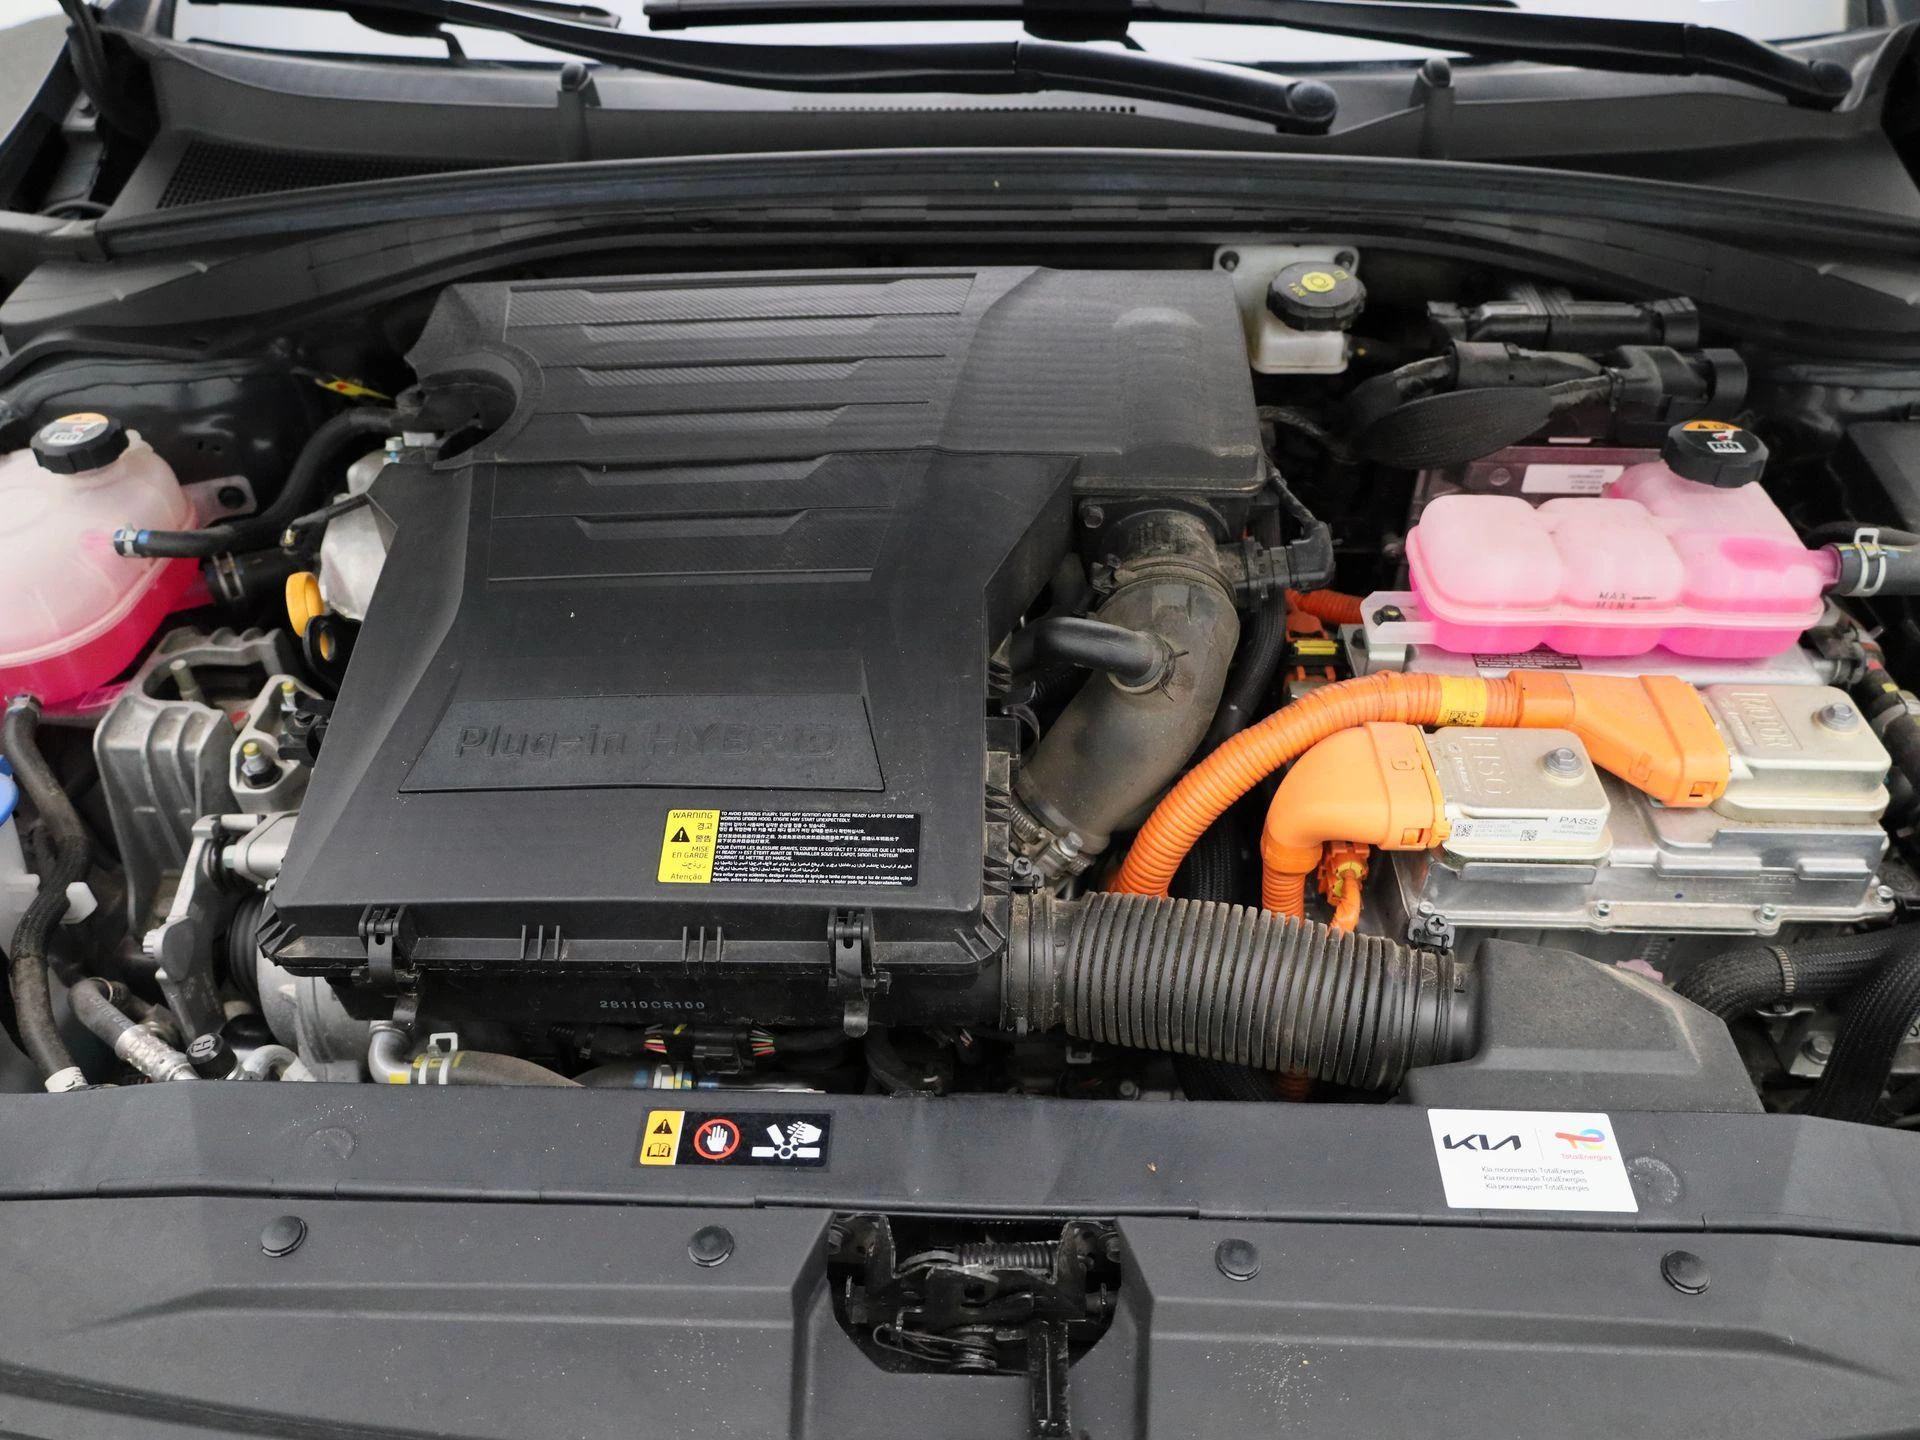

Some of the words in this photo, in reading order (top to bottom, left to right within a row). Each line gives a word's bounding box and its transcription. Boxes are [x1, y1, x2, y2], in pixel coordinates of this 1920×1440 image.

[454, 724, 628, 758] Plug-in
[1559, 816, 1598, 825] PASS
[599, 1000, 706, 1009] 28110CR100
[1443, 1134, 1522, 1150] KIA
